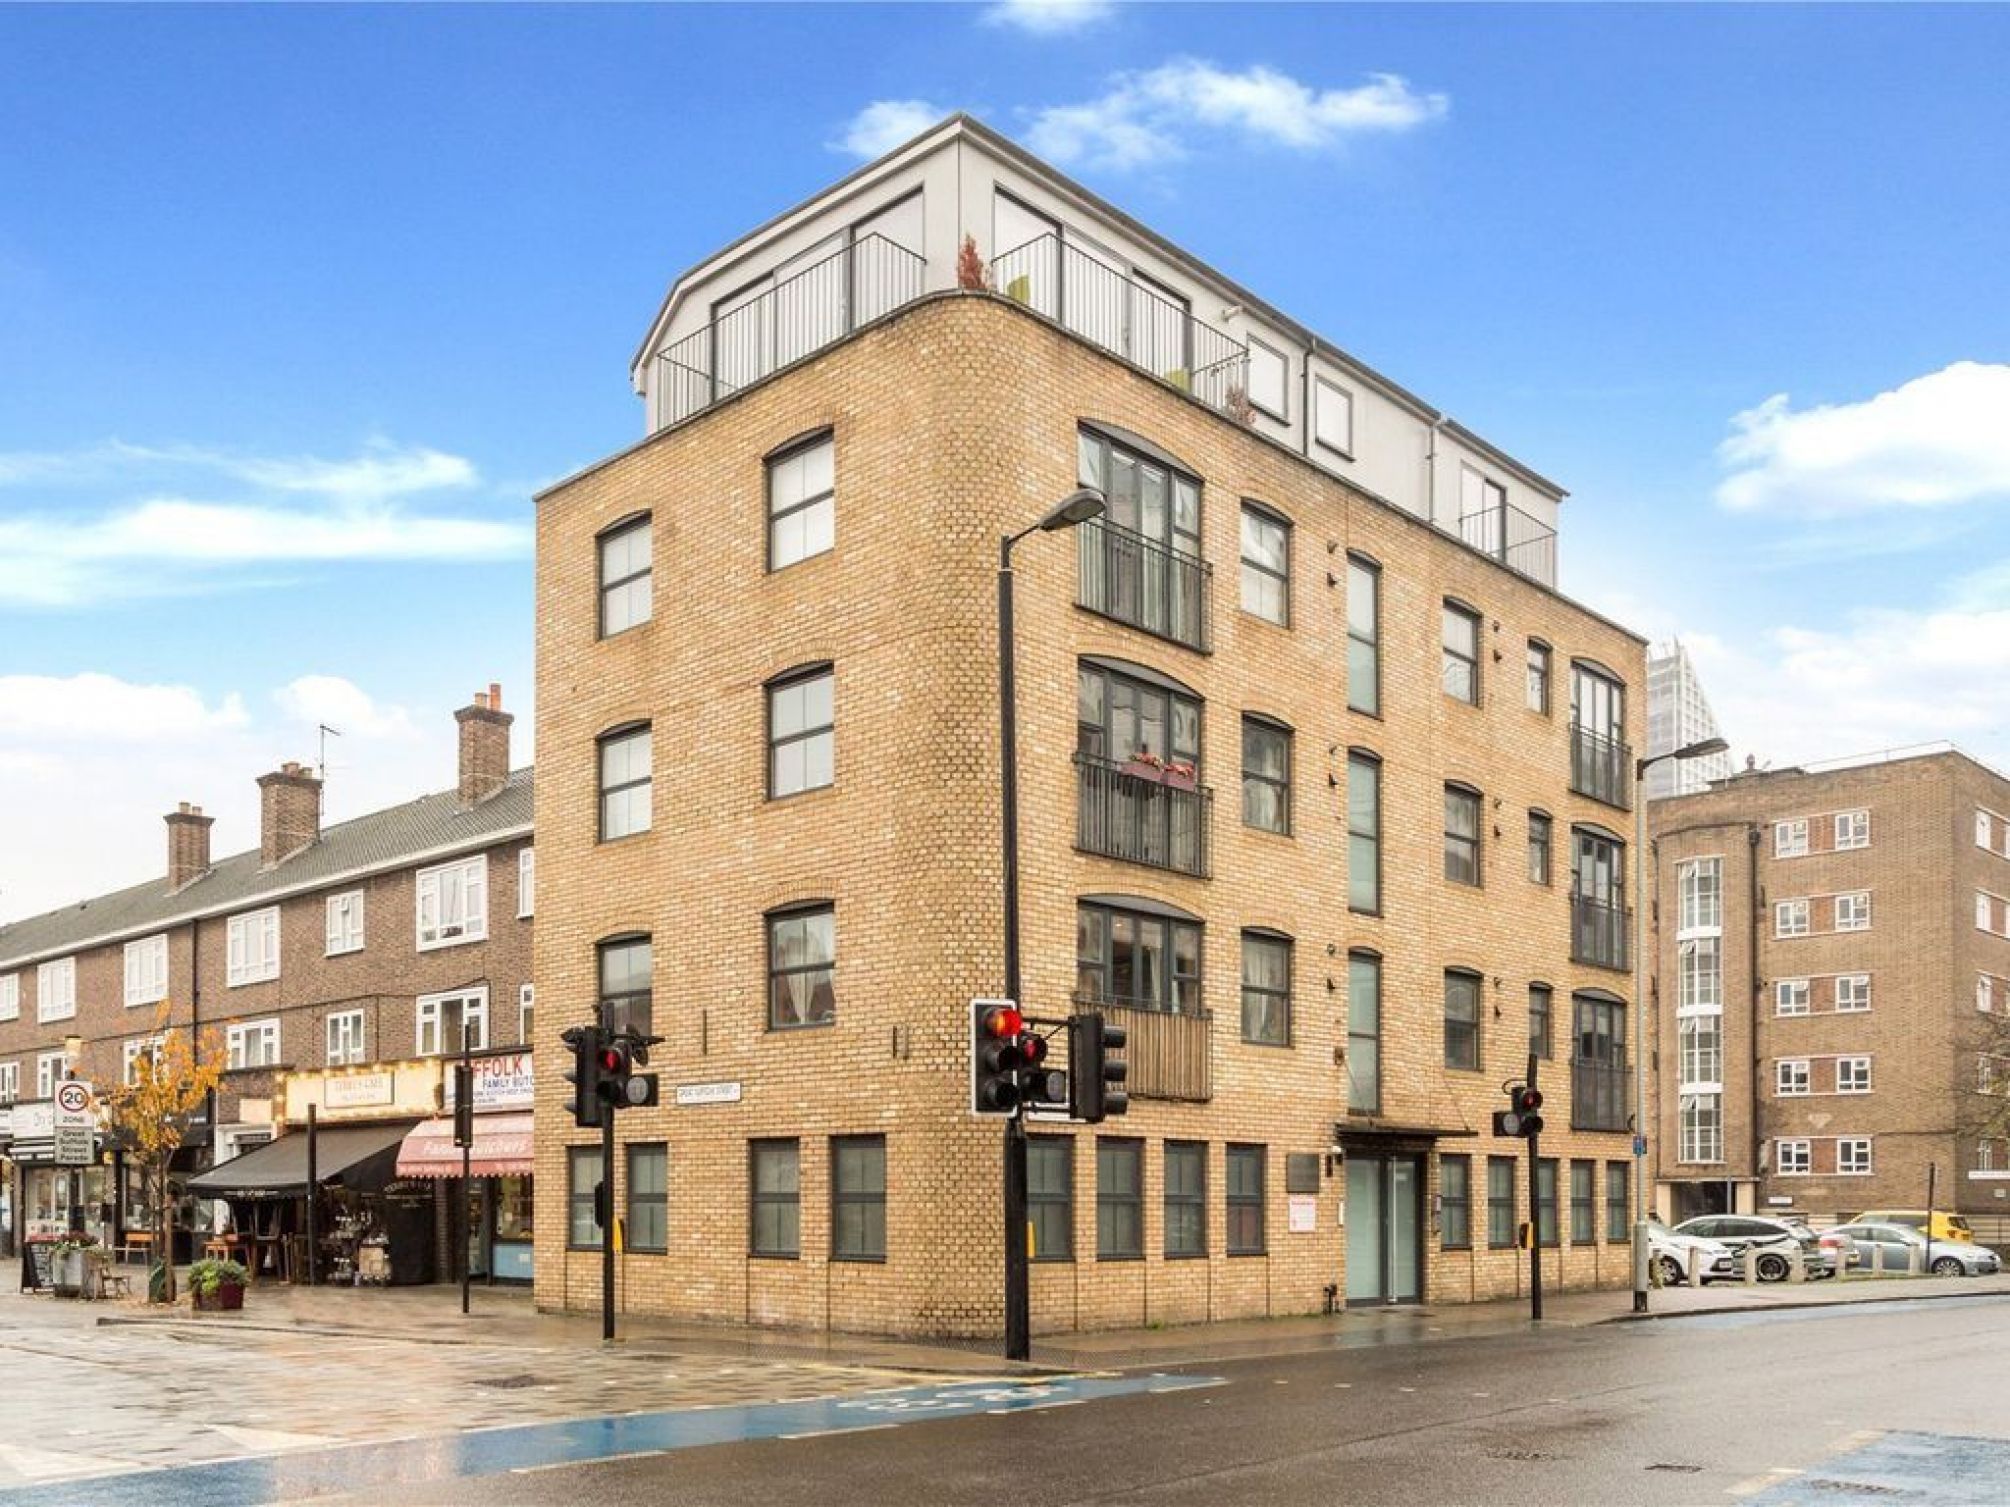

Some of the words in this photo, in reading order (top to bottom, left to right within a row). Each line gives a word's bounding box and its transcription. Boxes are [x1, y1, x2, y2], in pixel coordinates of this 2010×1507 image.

[464, 1056, 523, 1077] FFOLK
[64, 1091, 84, 1104] 20
[62, 1115, 84, 1123] ZONE
